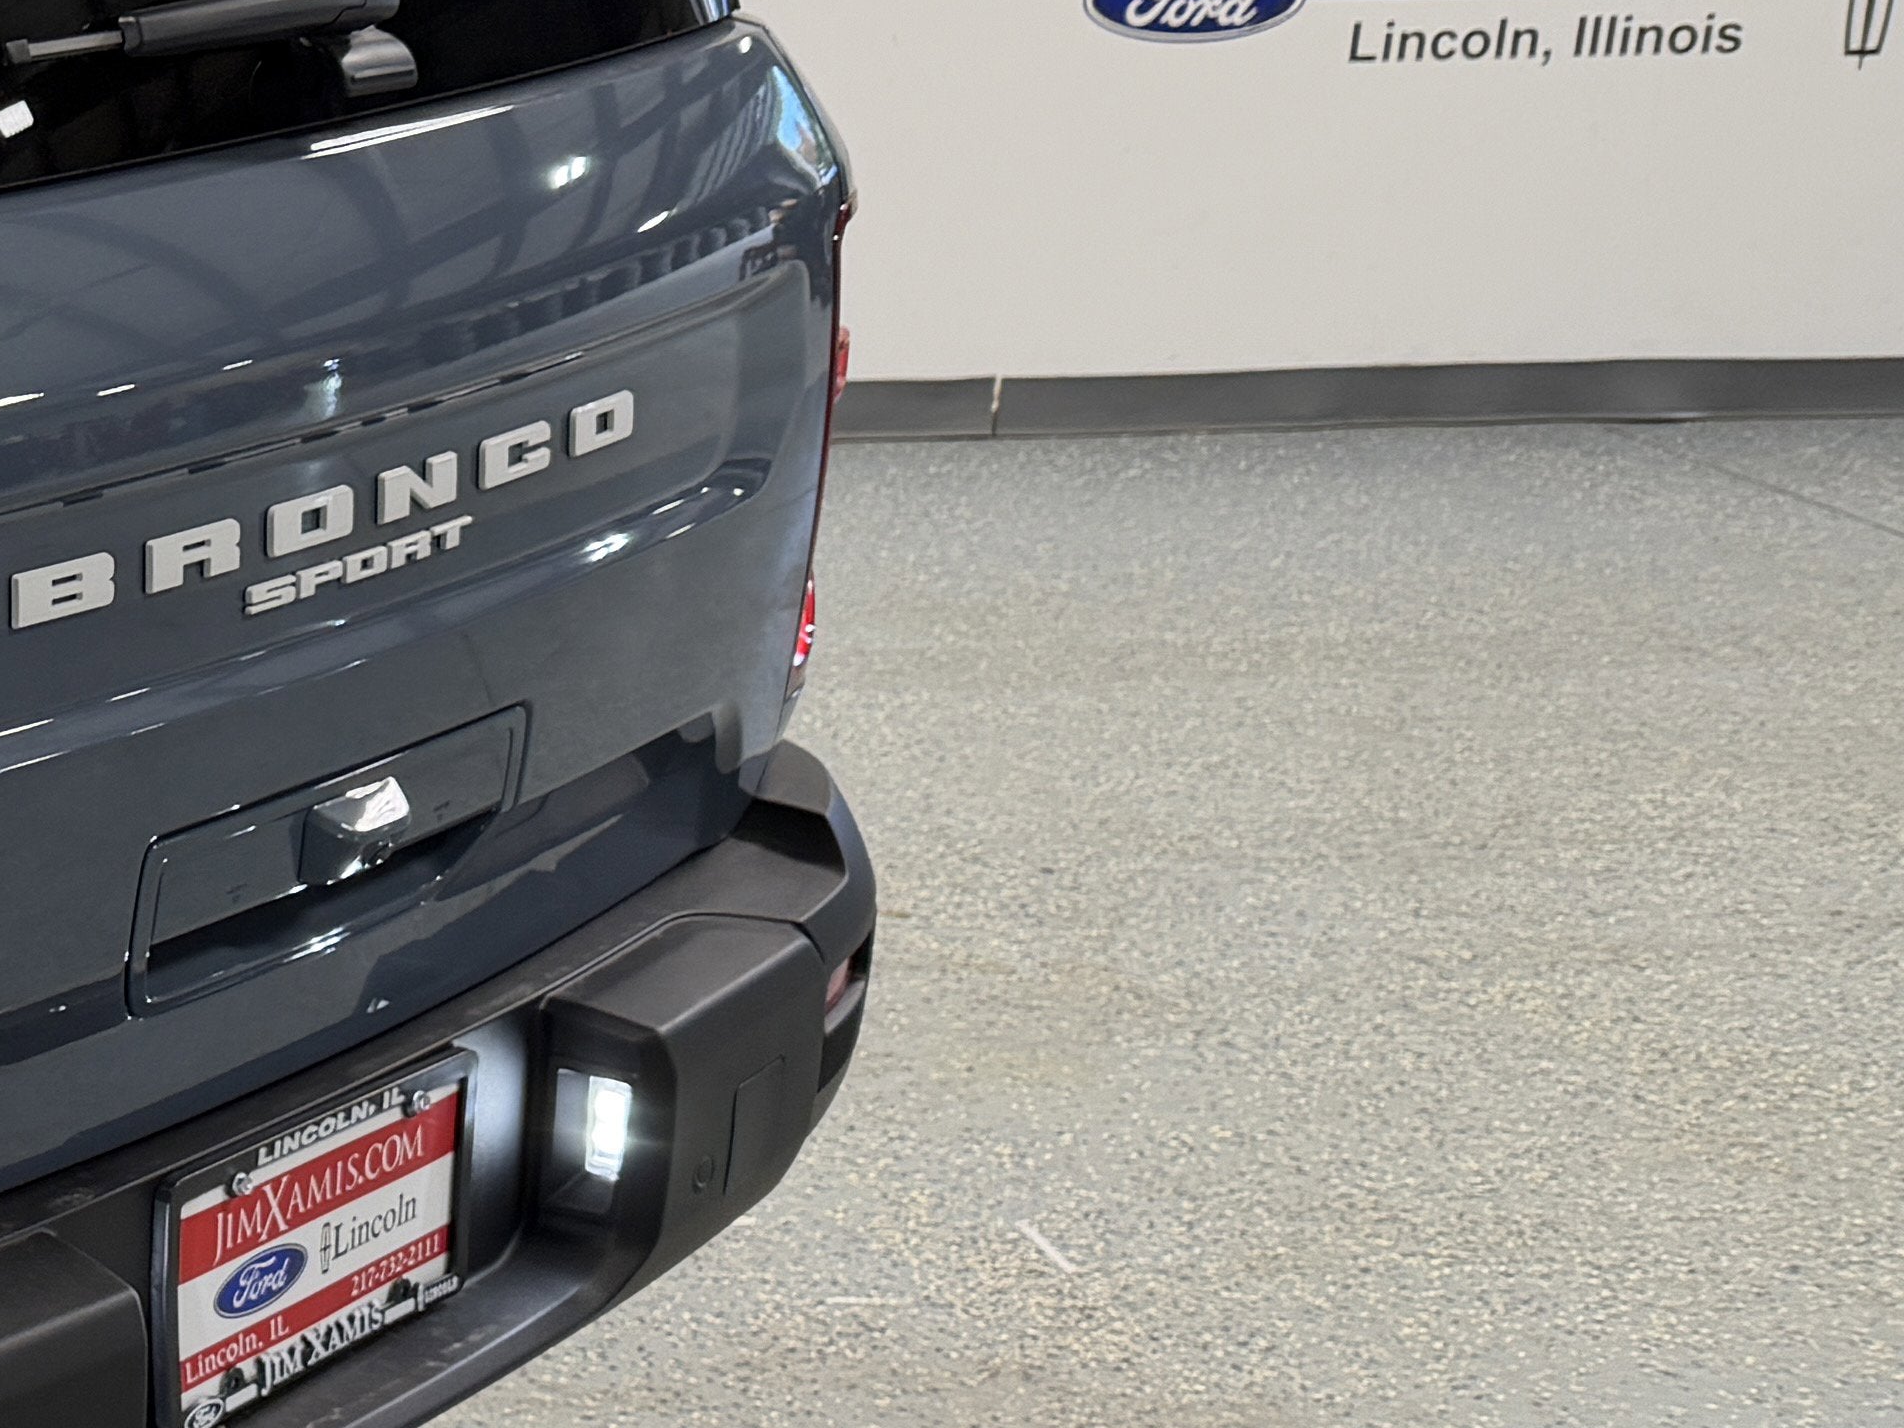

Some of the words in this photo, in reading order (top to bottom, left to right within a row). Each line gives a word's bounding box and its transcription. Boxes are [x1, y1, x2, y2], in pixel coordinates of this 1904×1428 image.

[1347, 17, 1553, 68] Lincoln,
[1572, 12, 1744, 59] Illinois
[9, 389, 635, 630] BRONCO
[242, 515, 474, 615] SPORT
[212, 1124, 424, 1268] JIMXAMIS.COM
[331, 1192, 417, 1260] Lincoln
[232, 1256, 288, 1309] Ford
[349, 1234, 441, 1298] 217-732-2111
[260, 1341, 306, 1397] JIM
[301, 1298, 384, 1367] XAMIS
[269, 1315, 290, 1341] IL
